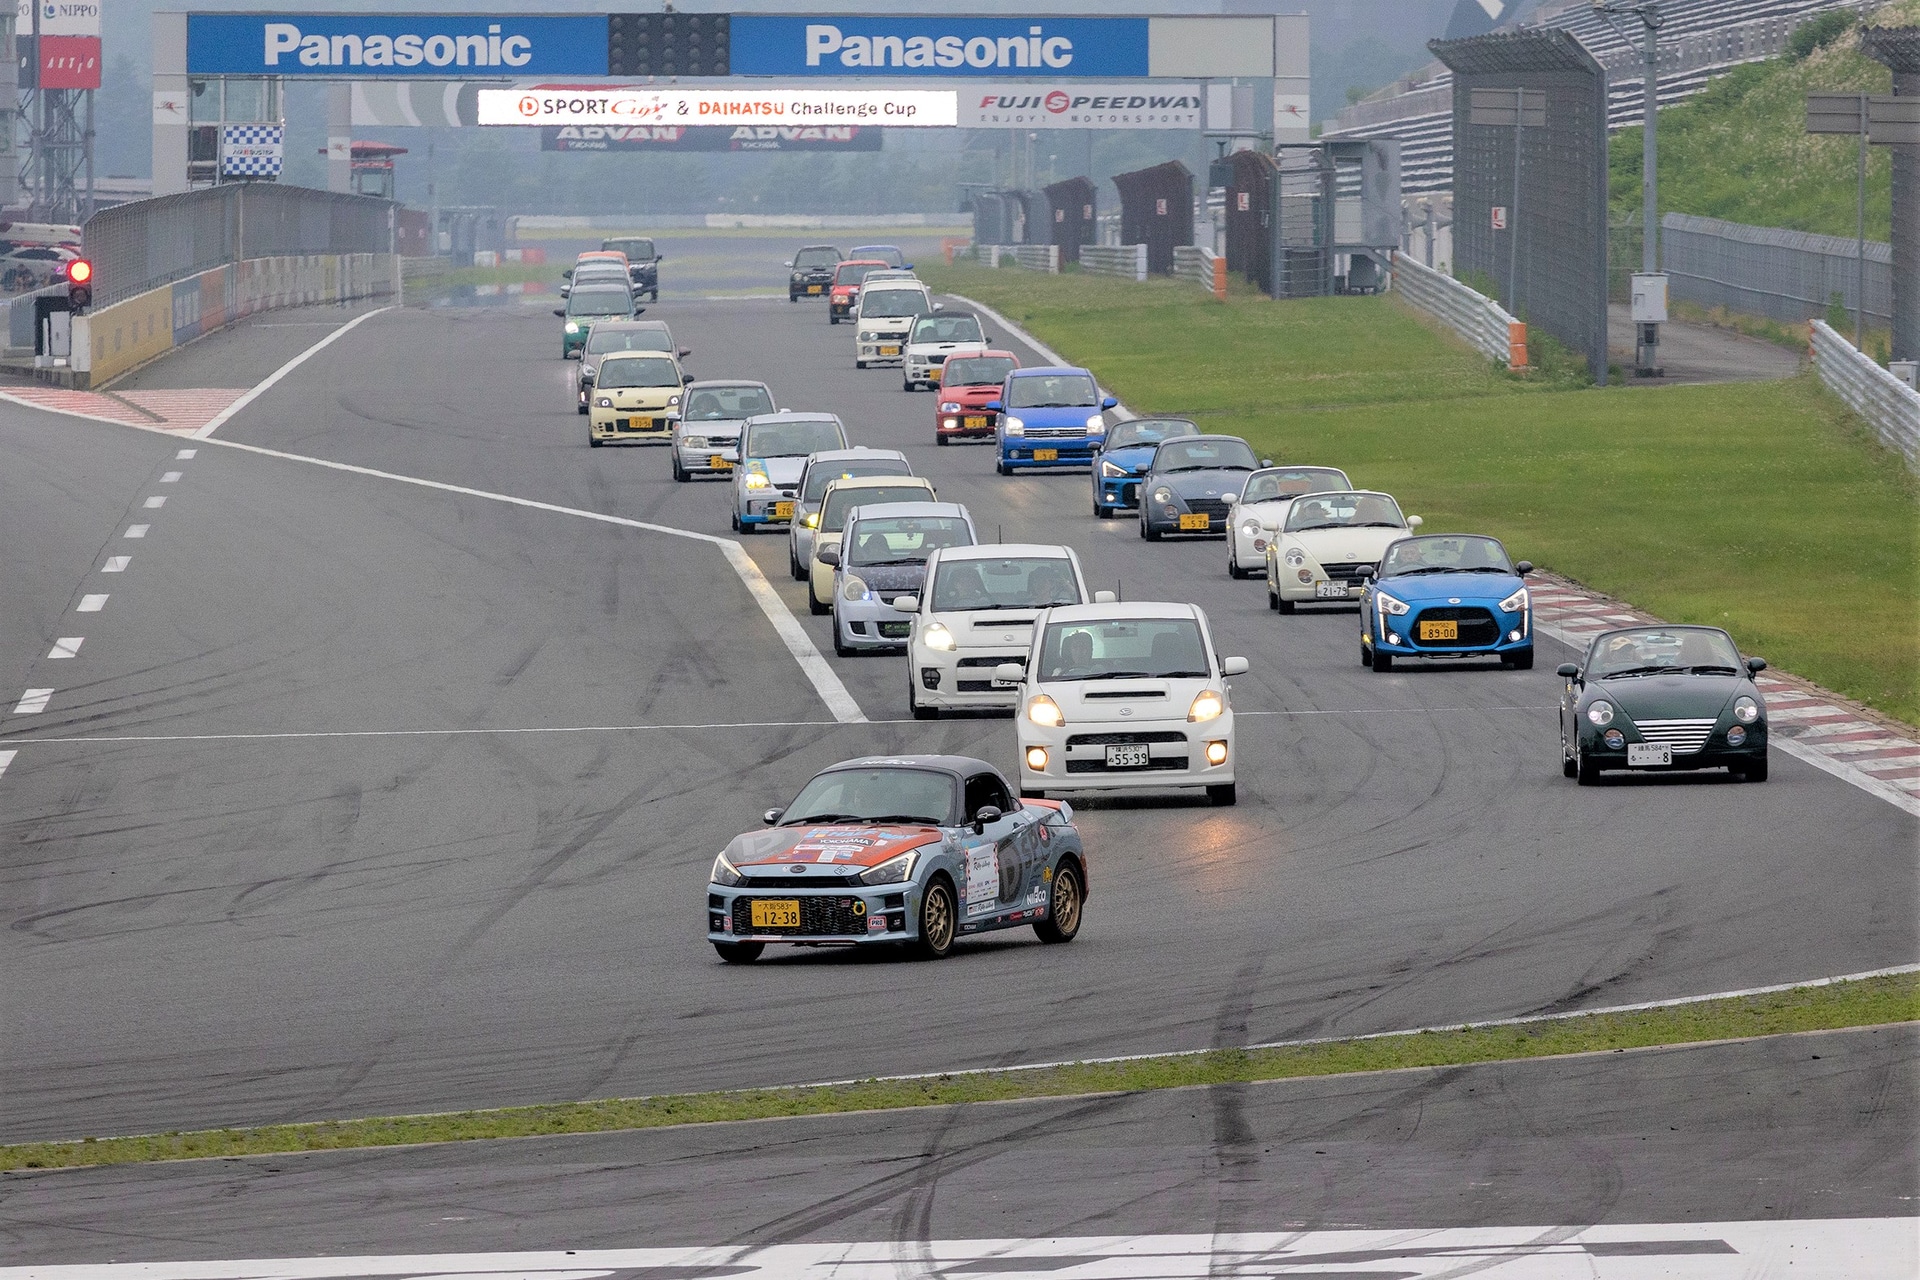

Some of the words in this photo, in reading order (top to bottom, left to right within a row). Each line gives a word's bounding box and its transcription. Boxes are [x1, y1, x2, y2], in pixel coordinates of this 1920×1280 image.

[60, 4, 98, 17] NIPPO
[264, 23, 531, 67] Panasonic
[806, 24, 1073, 68] Panasonic
[543, 99, 608, 114] SPORT
[677, 100, 689, 115] &
[698, 101, 784, 115] DAIHATSU
[790, 101, 878, 118] Challenge
[884, 101, 917, 117] Cup
[981, 114, 1046, 123] ENJOY!
[1071, 114, 1194, 123] MOTORSPORT
[556, 126, 680, 140] ADVAN
[730, 126, 855, 140] ADVAN
[1322, 586, 1348, 597] 21-79
[1428, 628, 1456, 639] 89-00
[1115, 752, 1148, 765] 55-99
[820, 837, 869, 846] YOKOHAMA
[763, 911, 798, 925] 12-38
